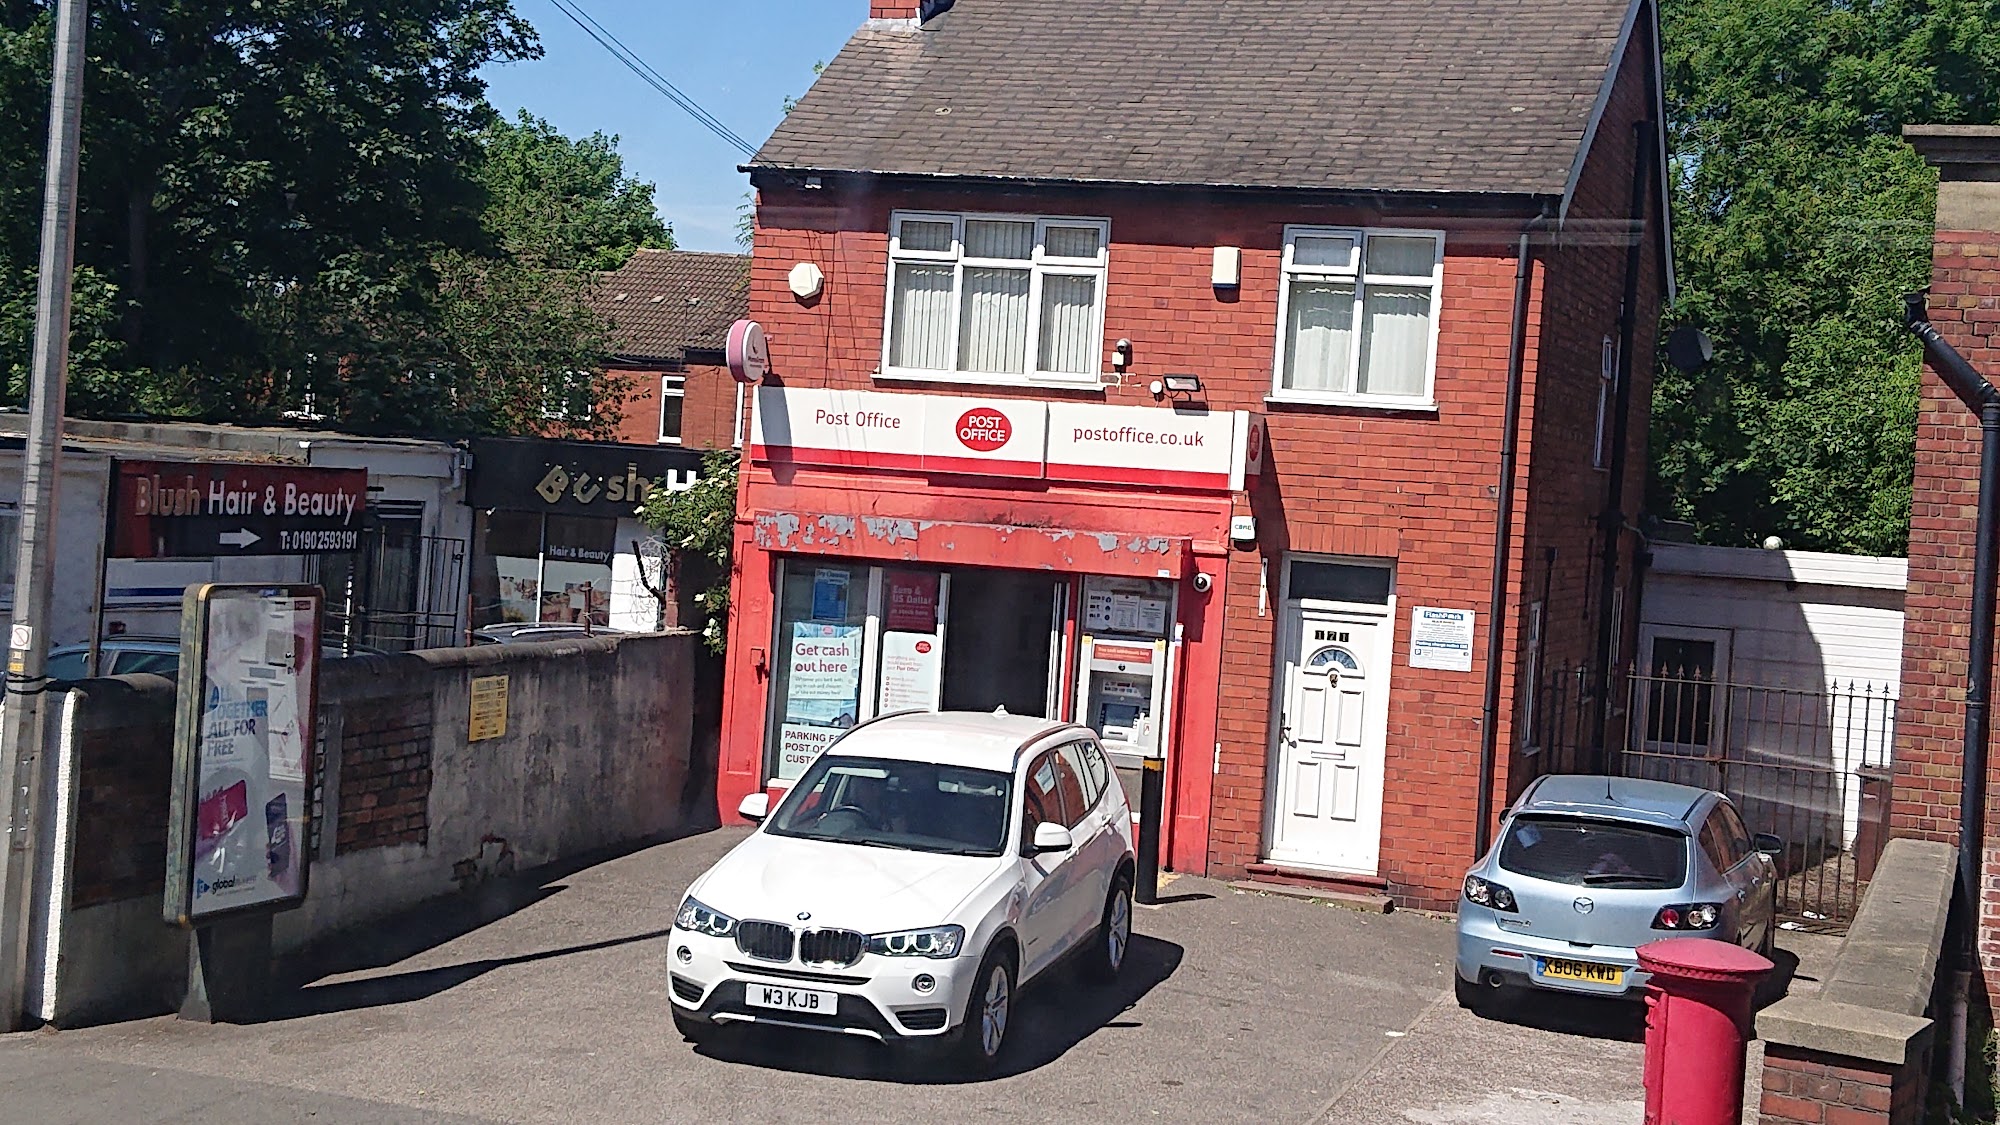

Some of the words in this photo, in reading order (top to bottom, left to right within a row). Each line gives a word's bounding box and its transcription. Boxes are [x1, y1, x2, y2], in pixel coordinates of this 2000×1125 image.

[815, 409, 850, 426] Post
[855, 411, 901, 429] Office
[968, 415, 1002, 429] POST
[960, 427, 1006, 442] OFFICE
[1073, 426, 1204, 447] postoffice.co.uk
[135, 474, 201, 516] Blush
[207, 479, 258, 515] Hair
[263, 484, 277, 516] &
[283, 482, 358, 526] Beauty
[549, 544, 569, 557] Hair
[570, 547, 577, 558] &
[578, 547, 610, 563] Beauty
[892, 594, 904, 603] US
[1315, 630, 1349, 642] 171
[795, 643, 819, 656] Get
[822, 642, 850, 657] cash
[795, 662, 816, 672] out
[819, 659, 848, 673] here
[206, 722, 230, 738] ALL
[234, 718, 256, 736] FOR
[785, 731, 826, 742] PARKING
[207, 740, 234, 757] FREE
[785, 743, 810, 752] POST
[1586, 964, 1615, 981] KWD
[763, 988, 783, 1005] W3
[787, 991, 819, 1009] KJB
